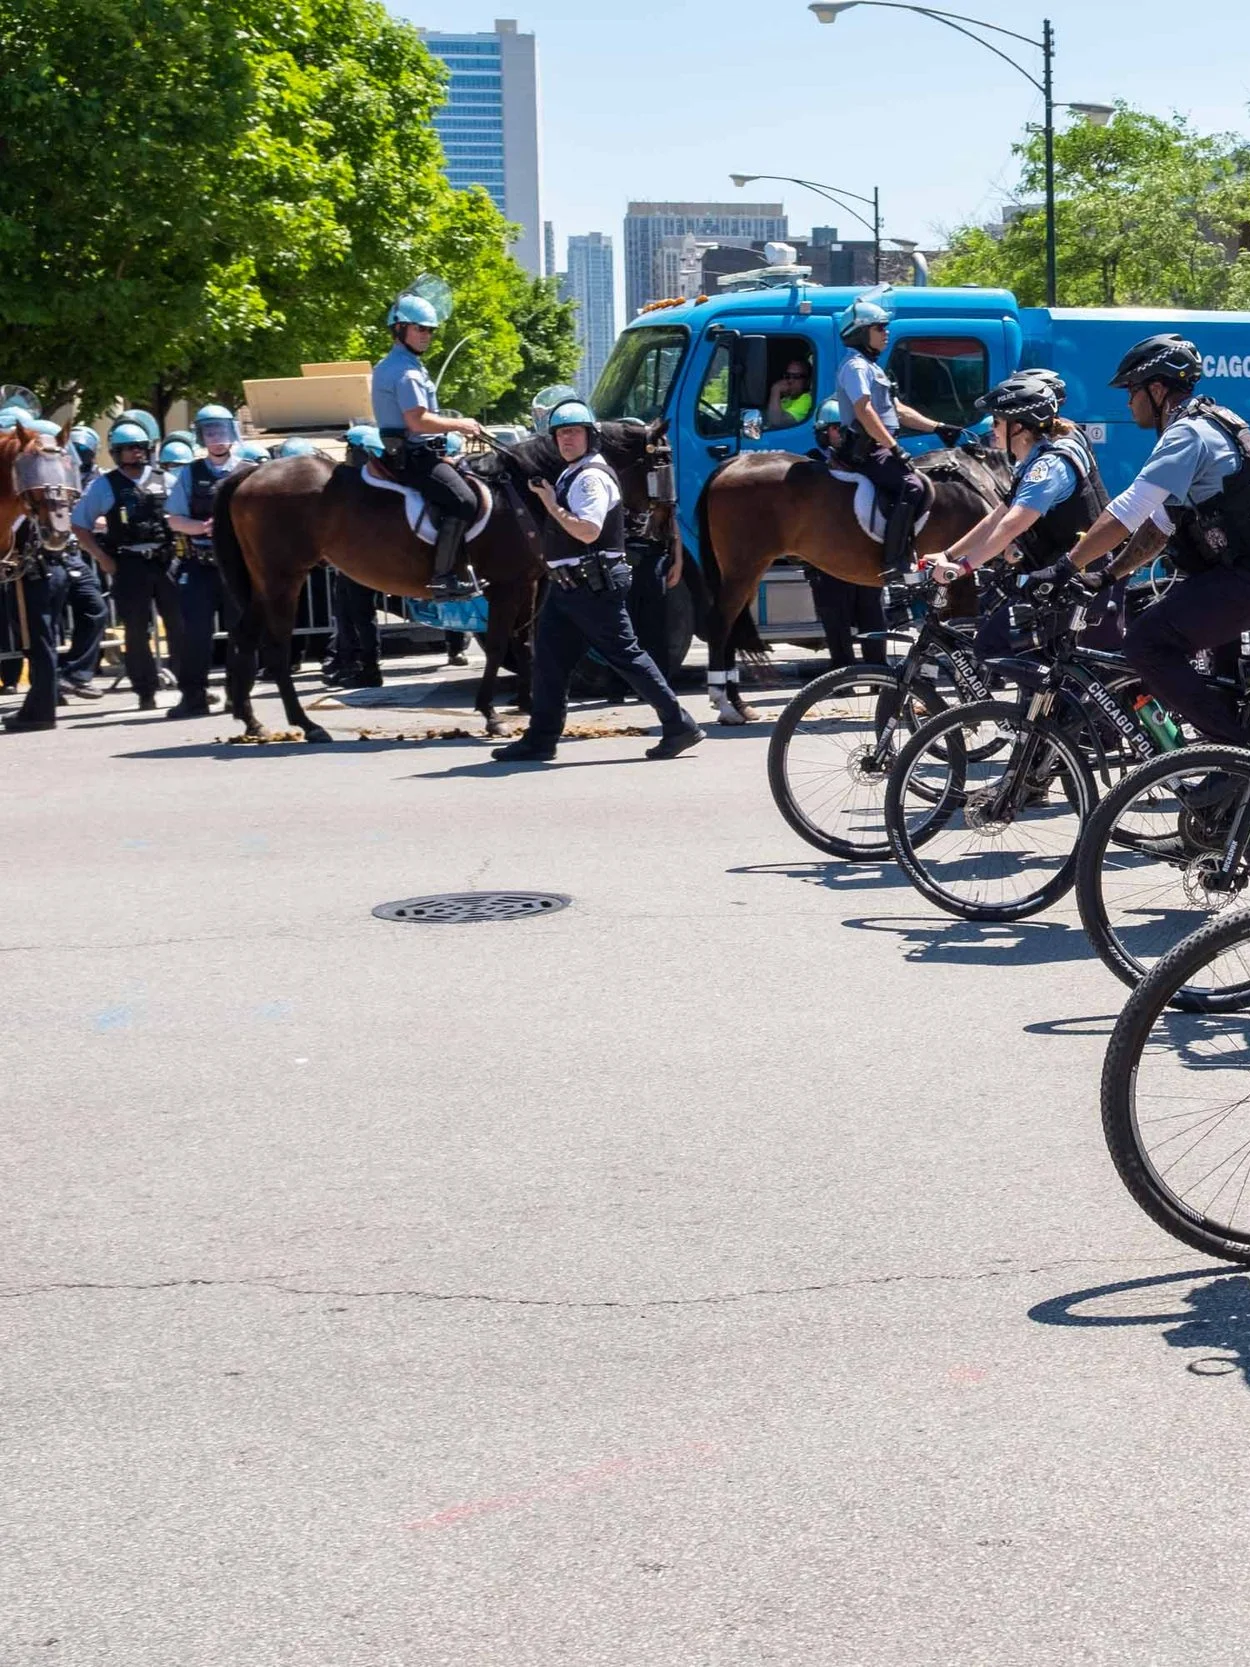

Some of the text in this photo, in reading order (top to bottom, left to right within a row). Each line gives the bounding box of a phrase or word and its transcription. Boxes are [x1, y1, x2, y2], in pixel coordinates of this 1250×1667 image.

[951, 650, 987, 698] CHICAGO
[1088, 682, 1154, 760] CHICAGO POL
